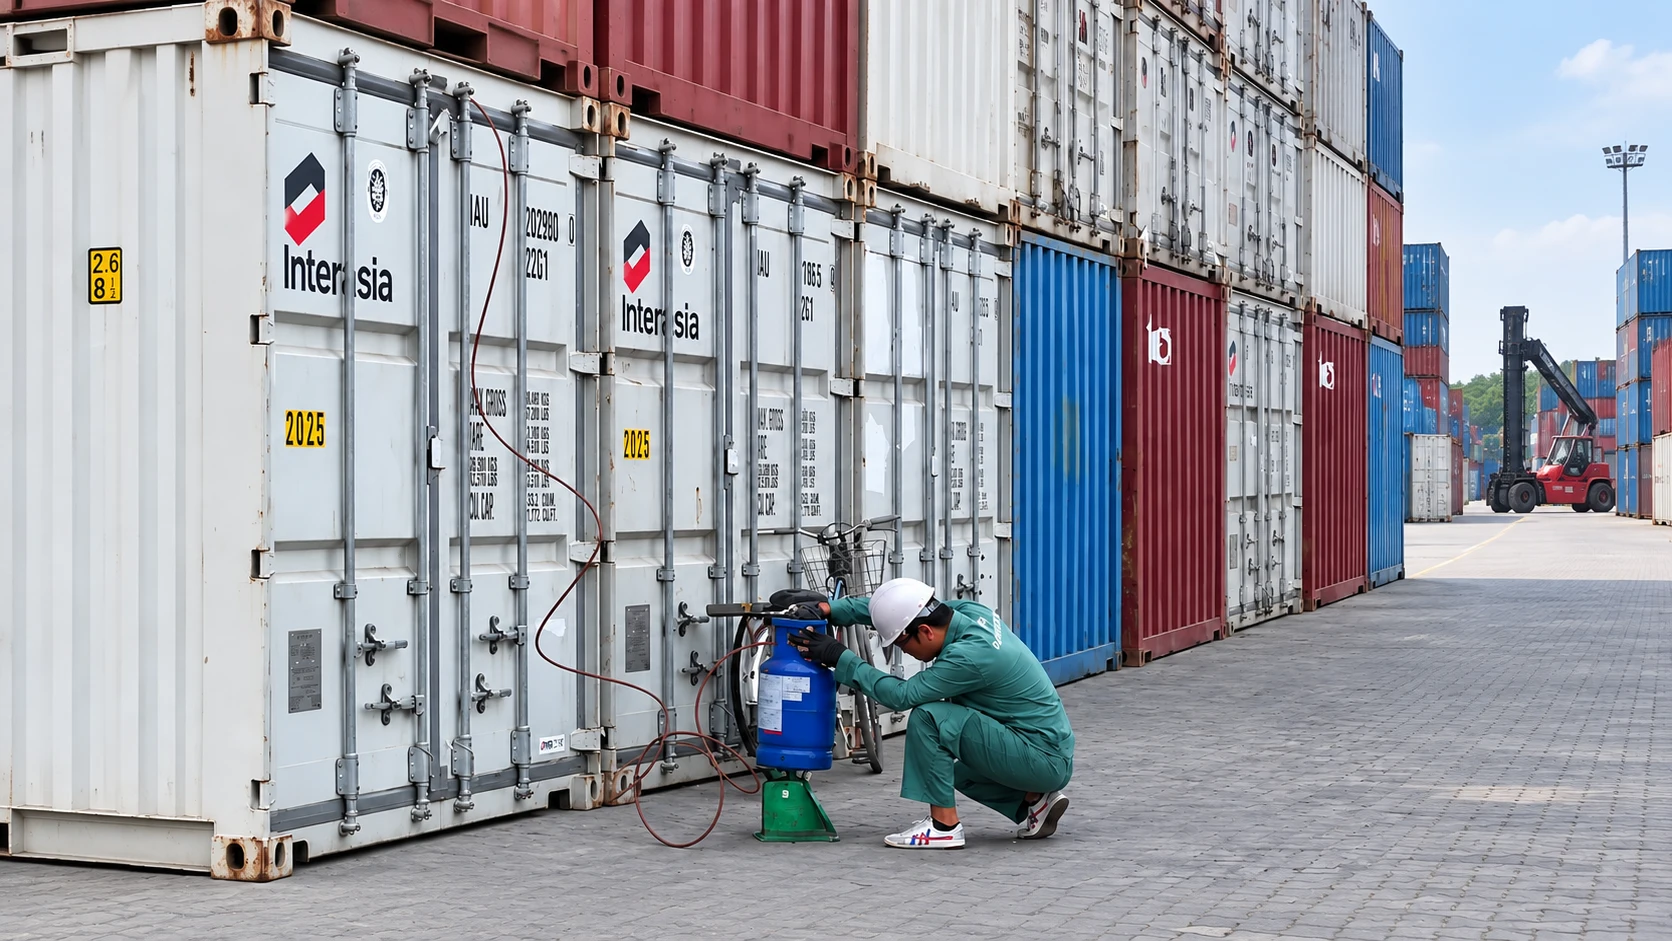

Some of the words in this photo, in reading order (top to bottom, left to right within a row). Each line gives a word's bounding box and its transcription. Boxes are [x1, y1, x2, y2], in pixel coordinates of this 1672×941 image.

[93, 252, 119, 274] 2.6
[94, 277, 106, 299] 8
[286, 411, 325, 446] 2025
[624, 430, 650, 458] 2025
